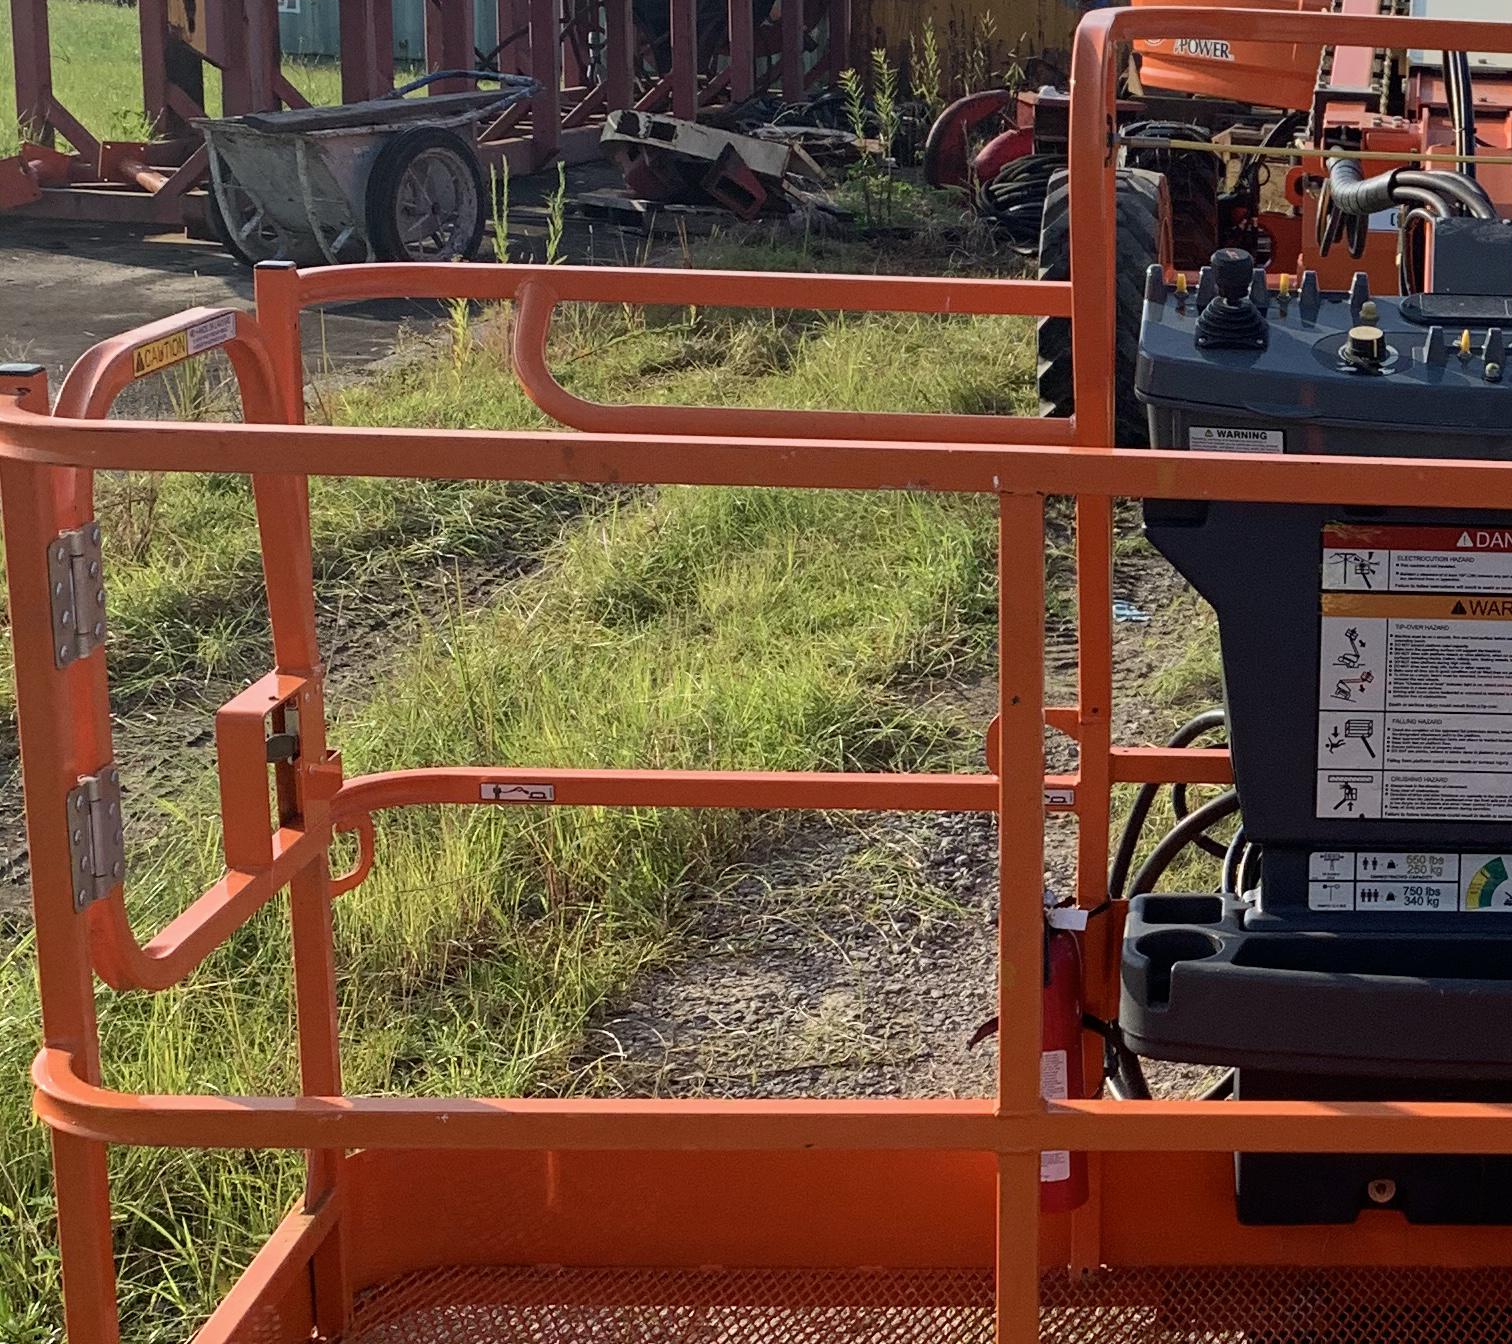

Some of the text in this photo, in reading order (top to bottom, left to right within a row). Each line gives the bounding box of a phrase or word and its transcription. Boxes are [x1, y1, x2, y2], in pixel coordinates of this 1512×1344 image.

[144, 333, 186, 367] CAUTION
[1217, 430, 1268, 440] WARNING
[1429, 855, 1445, 865] lbs
[1406, 864, 1443, 877] 250 kg
[1403, 886, 1441, 896] 750 lbs
[1404, 896, 1440, 908] 340 kg
